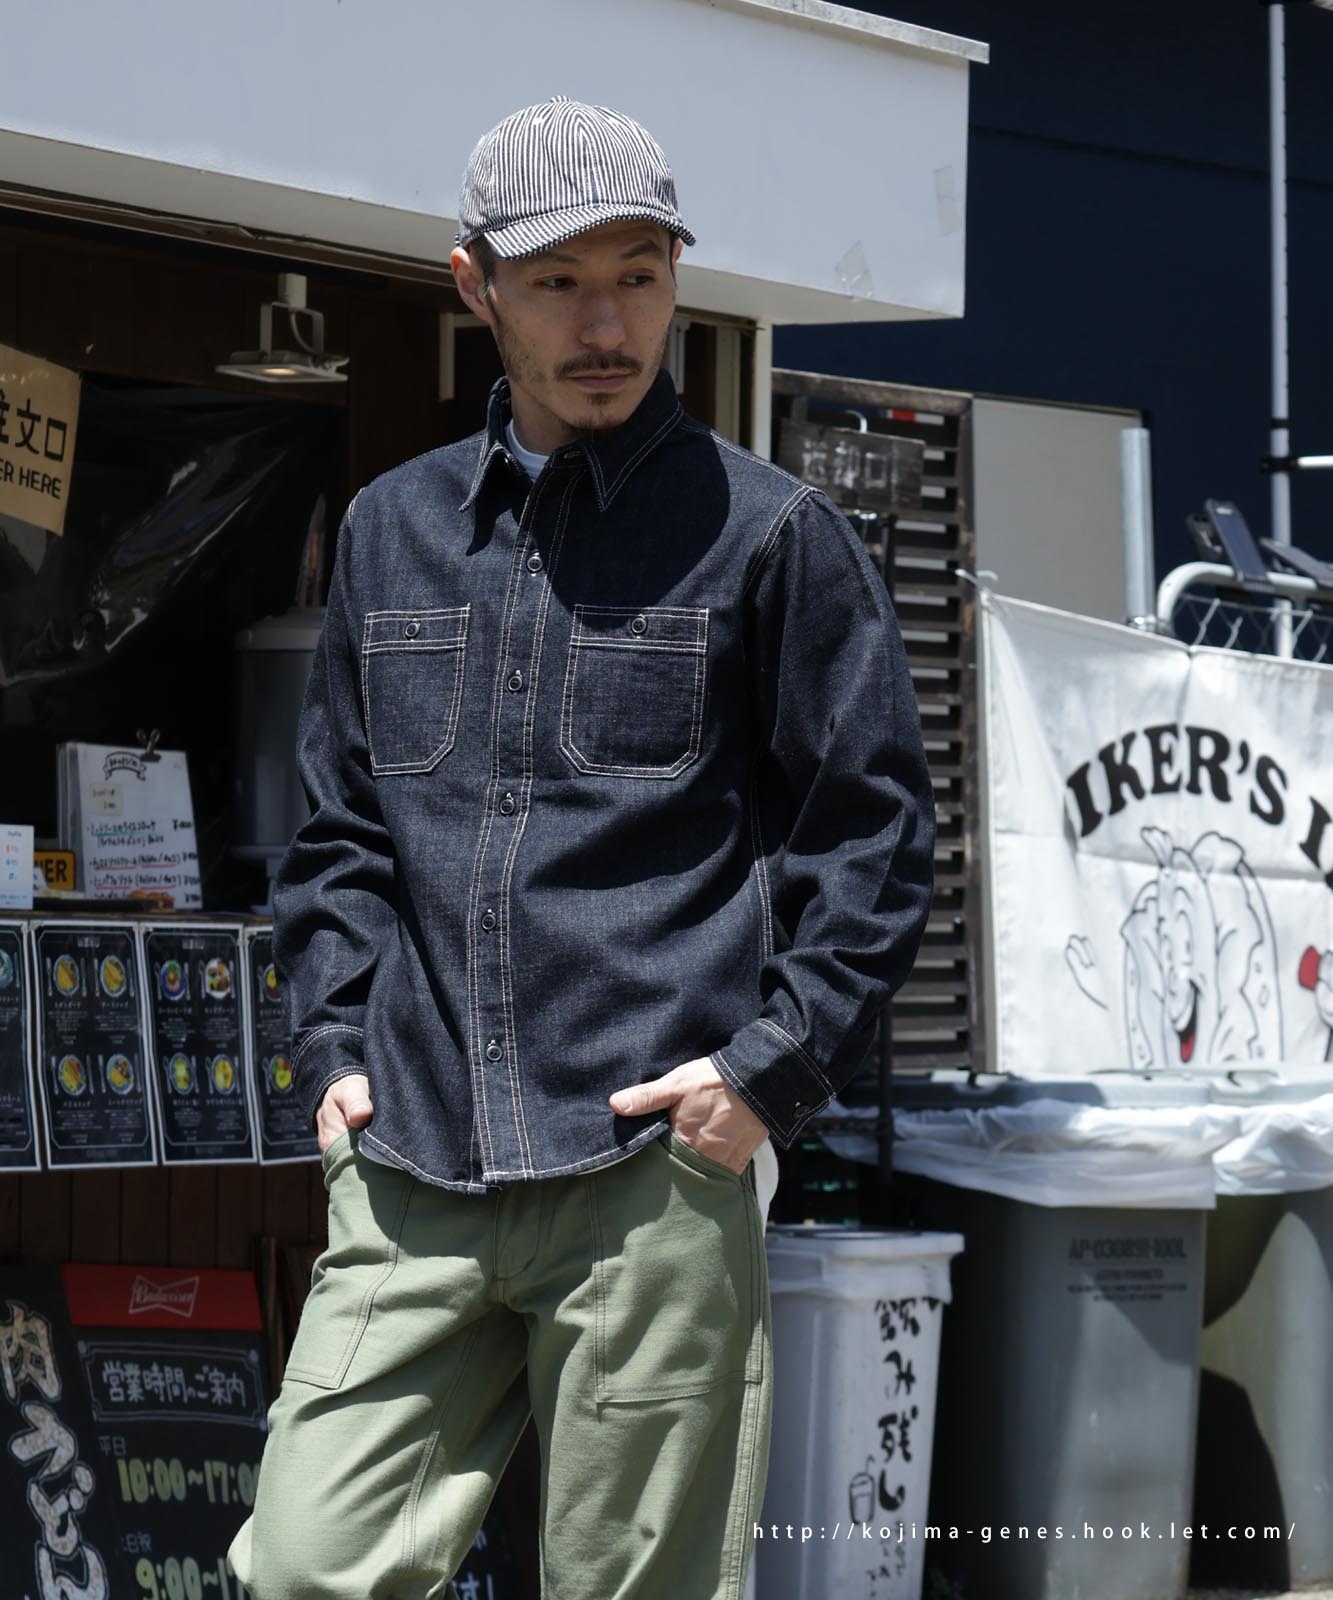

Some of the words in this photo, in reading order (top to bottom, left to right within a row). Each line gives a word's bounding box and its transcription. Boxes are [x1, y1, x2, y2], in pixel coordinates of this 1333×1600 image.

[19, 465, 63, 500] HERE
[1066, 722, 1288, 838] IKER'S
[102, 1360, 246, 1408] 営業時間のご案内
[98, 1435, 126, 1456] 平日
